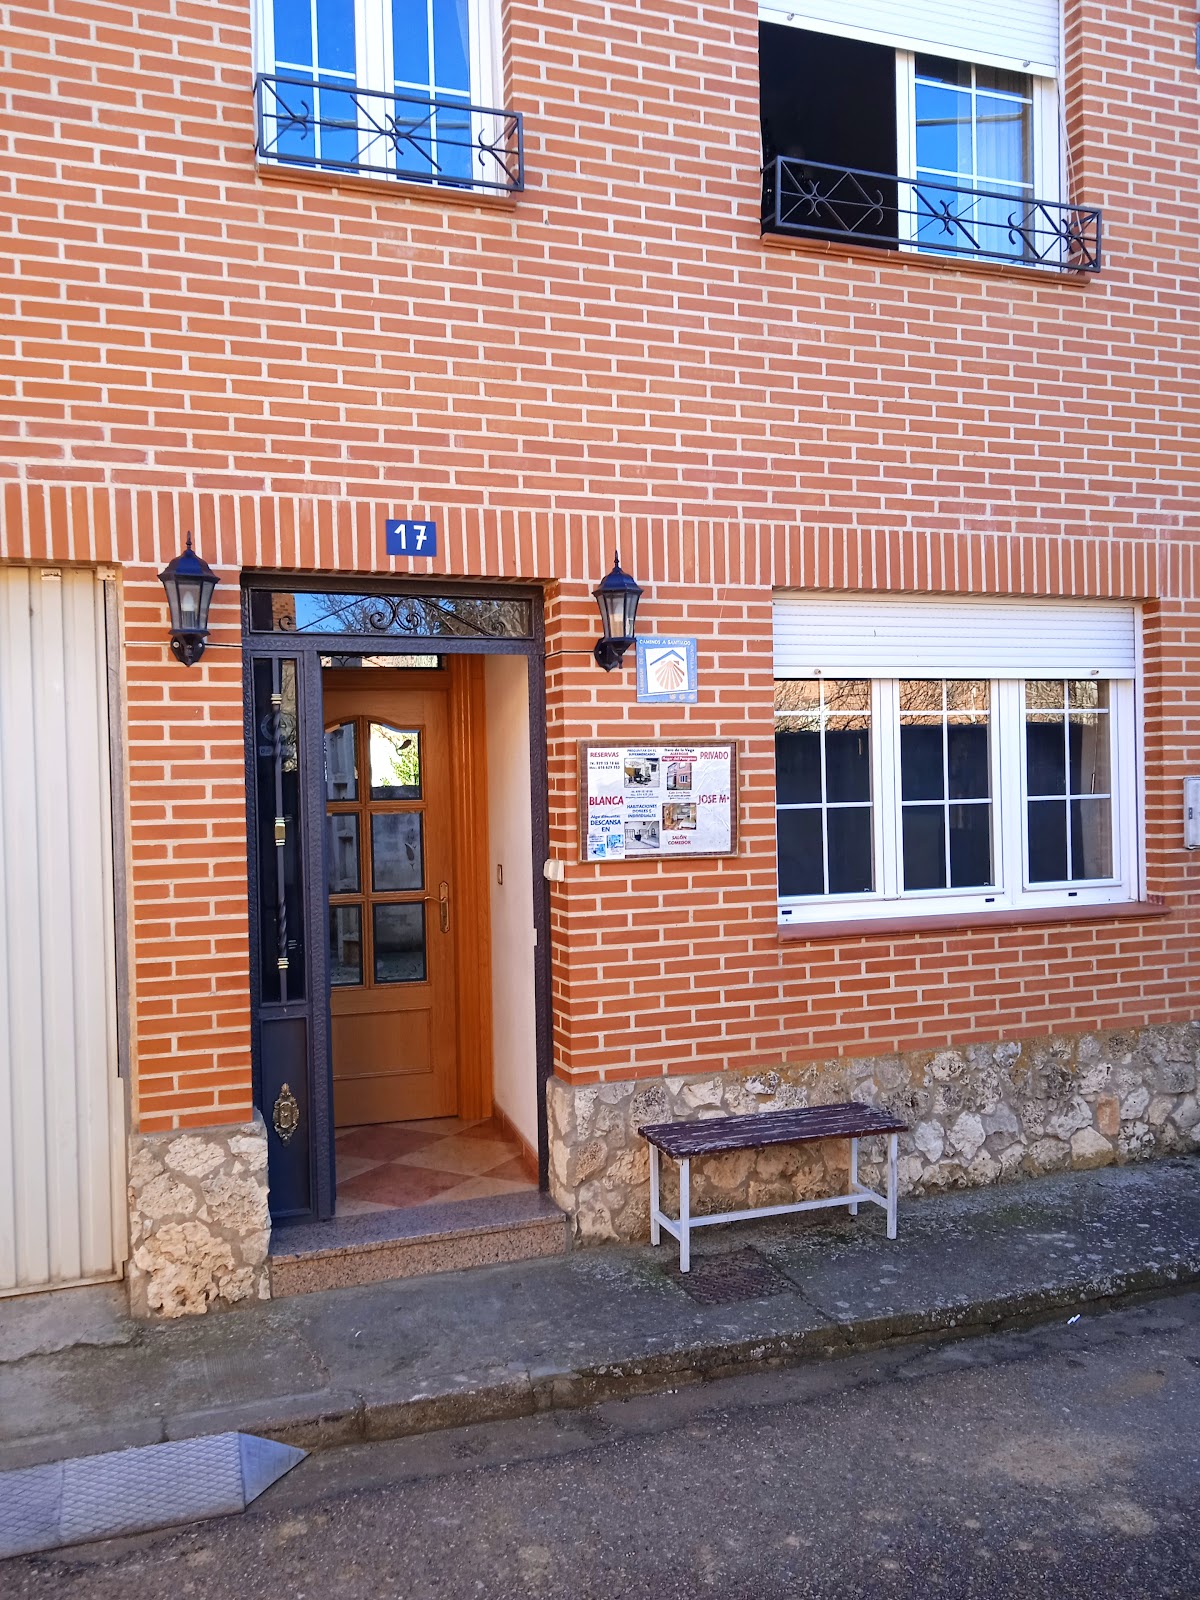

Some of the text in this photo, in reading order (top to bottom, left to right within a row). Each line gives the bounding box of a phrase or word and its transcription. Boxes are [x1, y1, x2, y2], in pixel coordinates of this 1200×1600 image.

[394, 524, 427, 550] 17
[590, 796, 624, 805] BLANCA
[697, 795, 717, 805] JOSE
